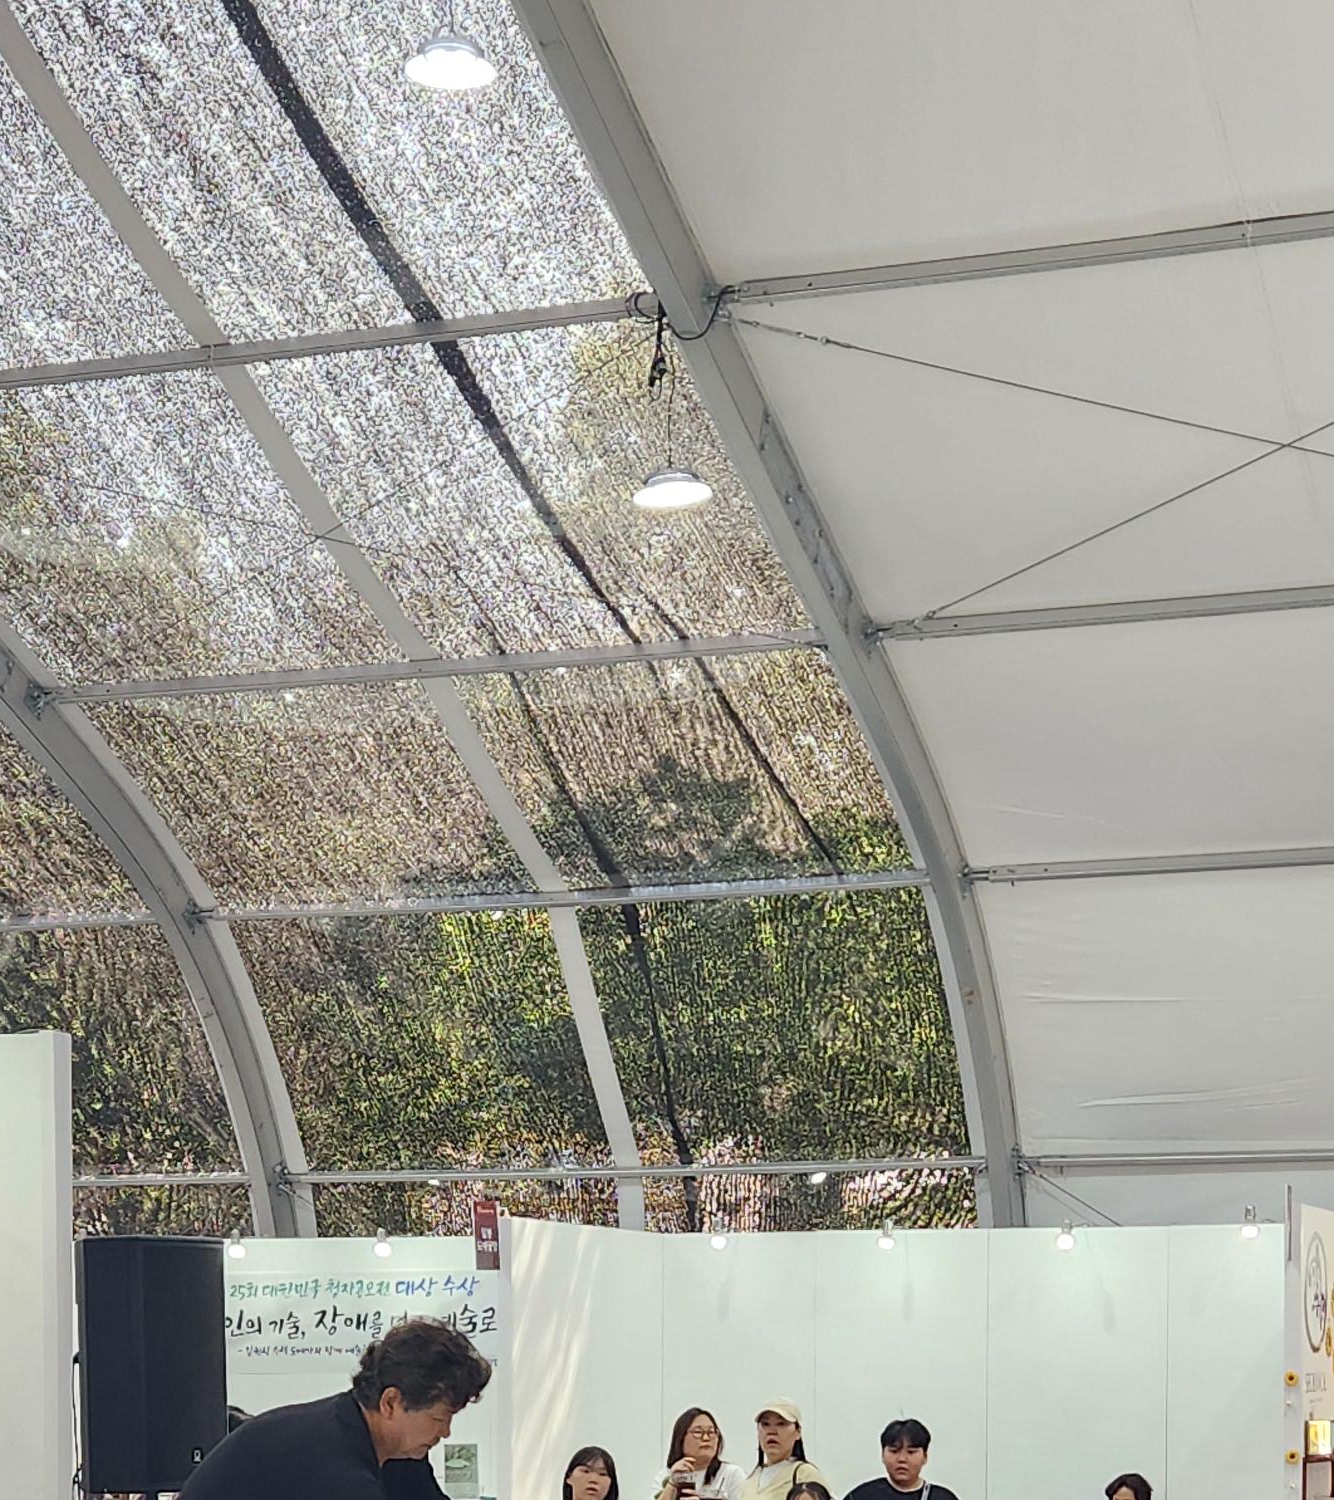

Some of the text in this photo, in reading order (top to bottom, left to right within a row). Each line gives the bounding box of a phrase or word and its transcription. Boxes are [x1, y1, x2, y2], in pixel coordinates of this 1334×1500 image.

[261, 1278, 322, 1300] 대한민국
[395, 1276, 439, 1297] 대상
[442, 1274, 481, 1297] 수상
[268, 1310, 306, 1340] 기술,
[313, 1304, 384, 1340] 장애를
